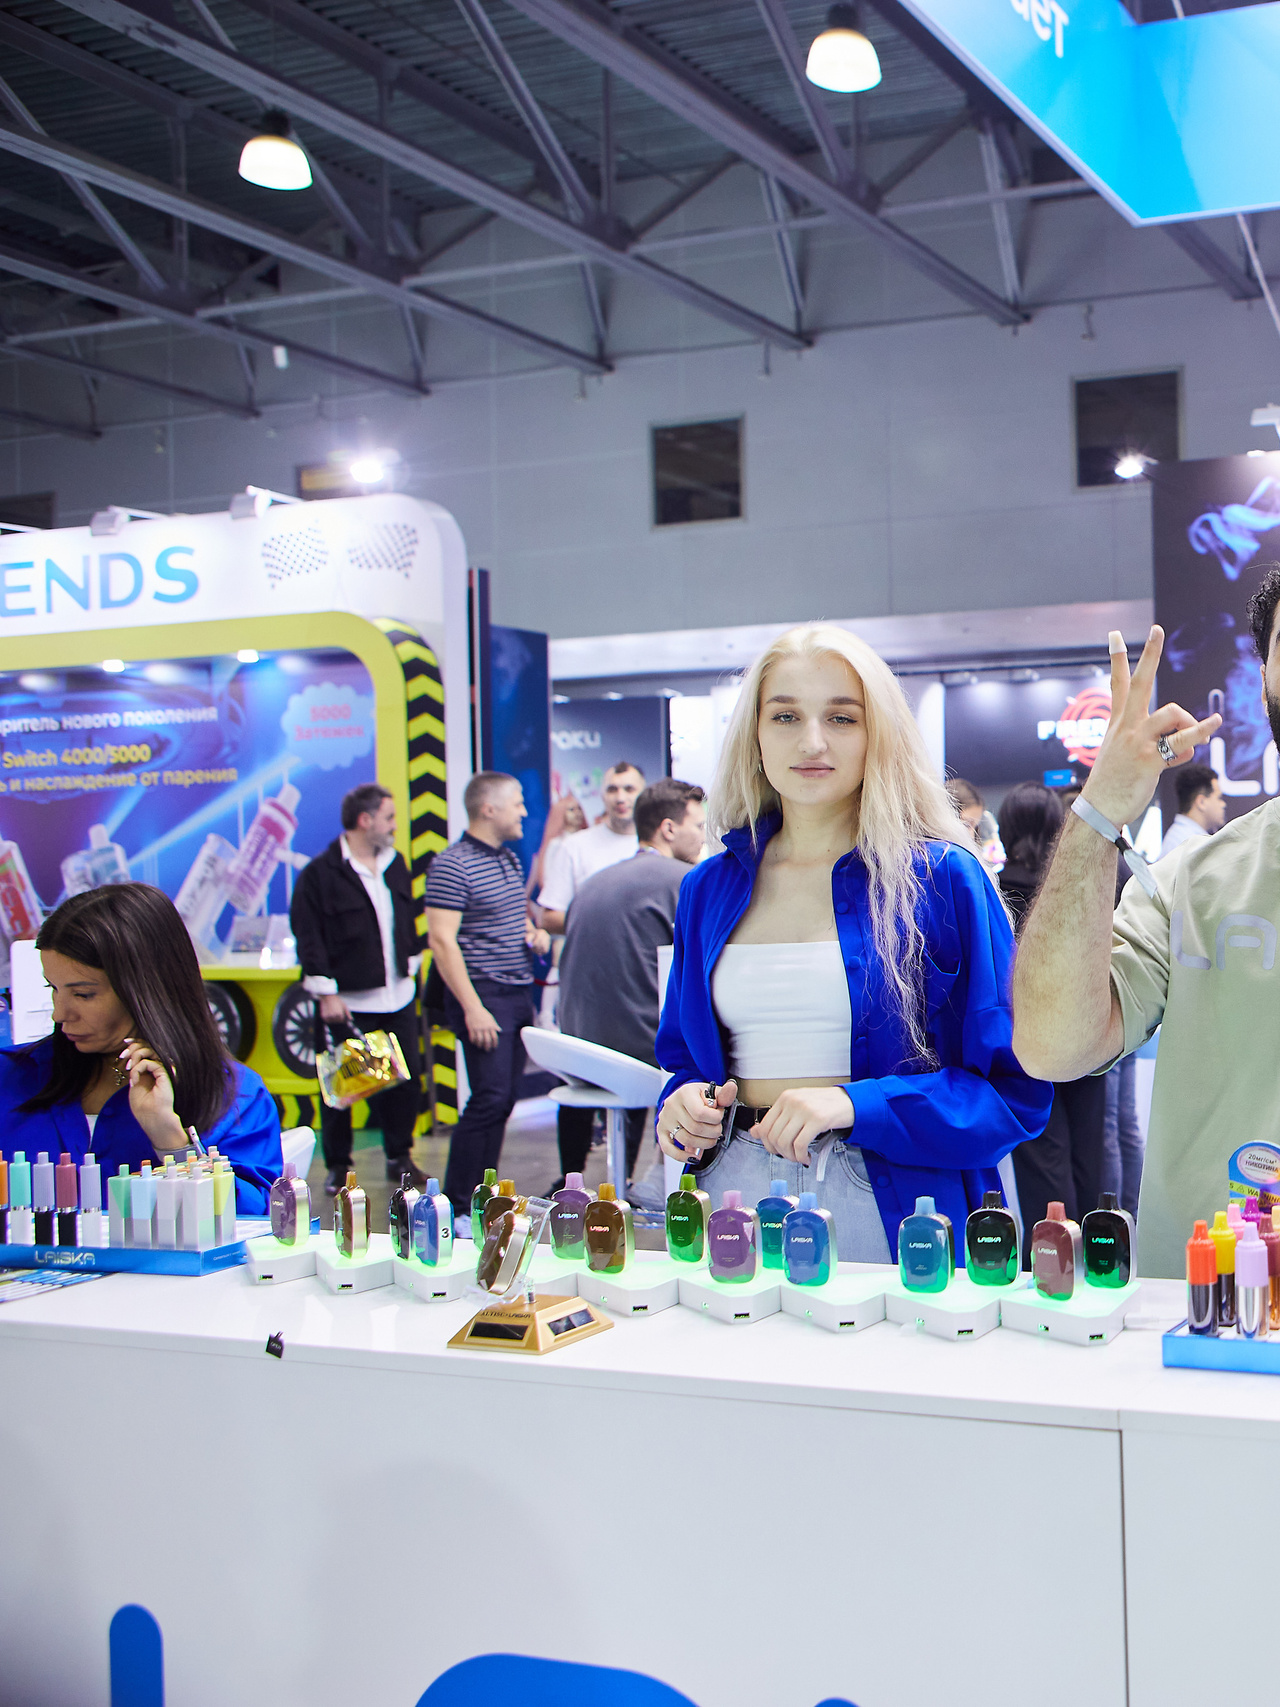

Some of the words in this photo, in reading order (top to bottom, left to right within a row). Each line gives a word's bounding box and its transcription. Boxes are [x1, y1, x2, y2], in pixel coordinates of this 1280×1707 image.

[0, 545, 200, 617] ENDS
[62, 710, 121, 730] нового
[122, 706, 219, 729] поколения
[3, 750, 58, 769] Switch
[60, 743, 151, 765] 4000/5000
[27, 773, 137, 795] наслаждение
[139, 771, 161, 786] от
[163, 767, 239, 789] парения
[1245, 1160, 1279, 1173] НИКОТИНА
[441, 1227, 450, 1239] 3
[34, 1250, 96, 1266] LAISKA
